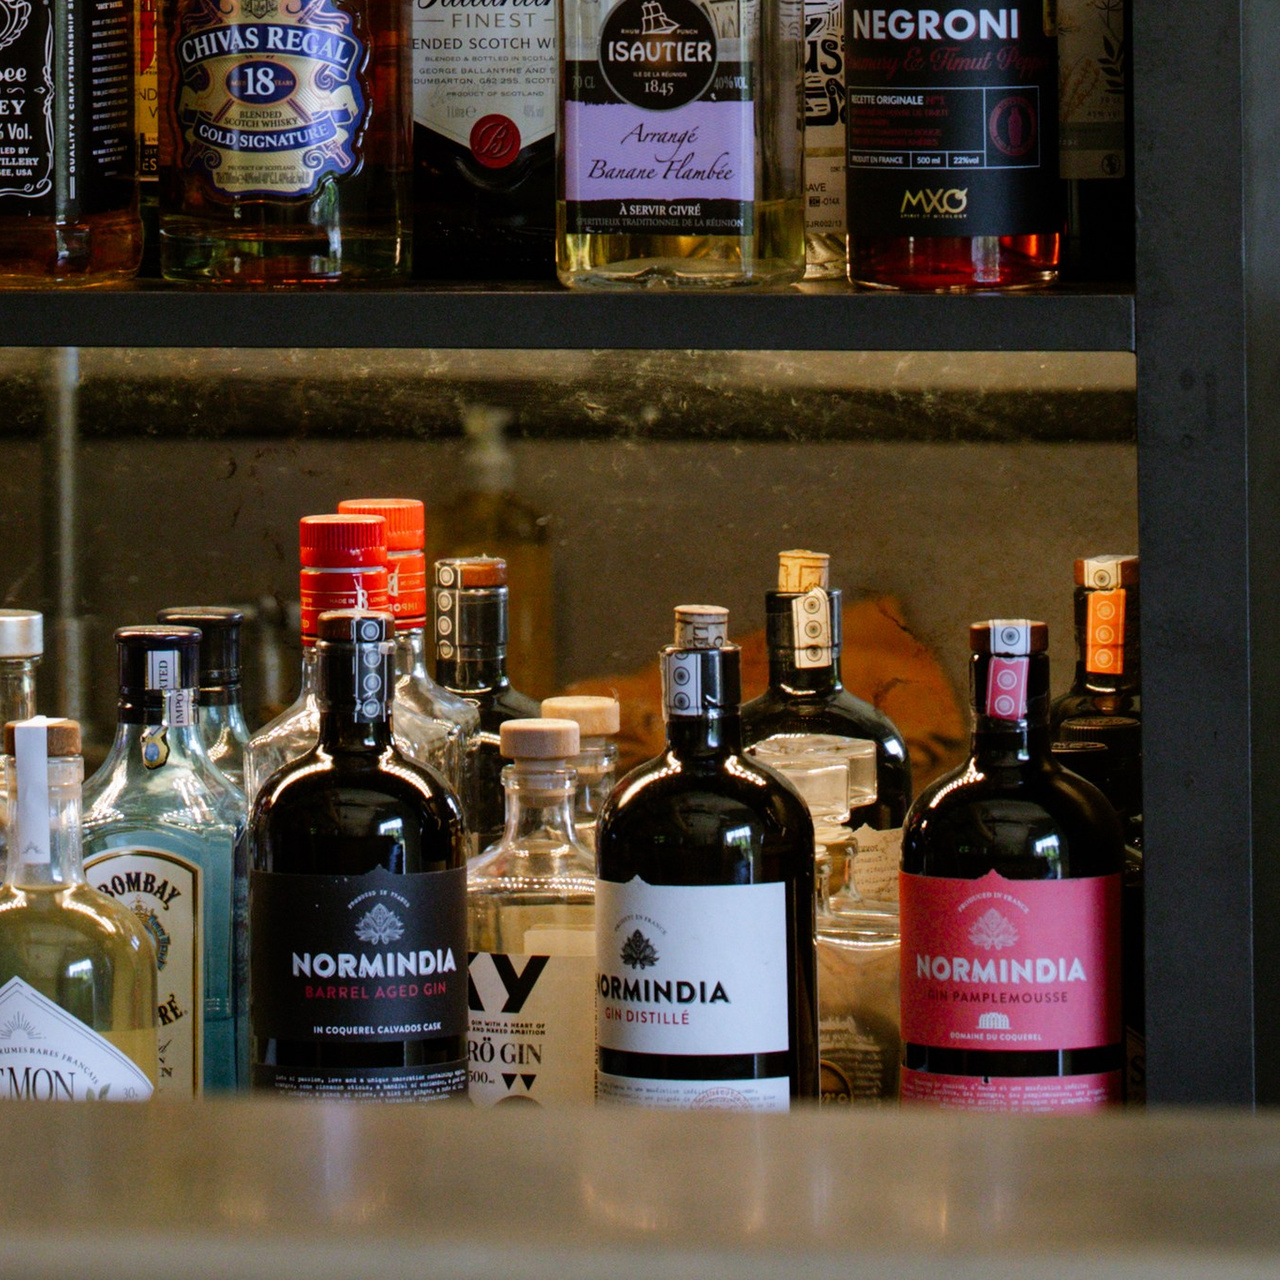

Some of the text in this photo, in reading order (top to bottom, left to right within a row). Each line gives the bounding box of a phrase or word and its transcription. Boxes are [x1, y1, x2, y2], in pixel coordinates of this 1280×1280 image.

[451, 12, 537, 28] FINEST
[852, 7, 1020, 41] NEGRONI
[182, 26, 349, 64] CHIVAS REGAL
[468, 37, 531, 50] SCOTCH
[608, 40, 713, 63] ISAUTIER
[67, 13, 75, 109] CRAFTSMANSHIP
[419, 67, 457, 75] GEORGE
[242, 67, 276, 96] 18
[644, 80, 674, 97] 1845
[876, 94, 924, 105] ORIGINALE
[223, 116, 300, 128] SCOTCH WHISKY
[239, 110, 282, 119] BLENDED
[7, 122, 33, 140] Vol.
[199, 122, 329, 148] GOLD SIGNATURE
[17, 146, 30, 155] BY
[68, 124, 76, 173] QUALITY
[621, 123, 700, 163] Arrangé
[587, 151, 736, 182] Banane Flambée
[878, 156, 904, 164] FRANCE
[15, 168, 33, 177] USA
[629, 202, 701, 216] SERVIR GIVRÉ
[900, 187, 969, 215] MXO
[704, 216, 744, 228] RÉUNION
[99, 871, 182, 910] BOMBAY
[957, 891, 1030, 915] PRODUCED FRANCE
[291, 947, 457, 978] NORMINDIA
[916, 954, 1088, 984] NORMINDIA
[304, 982, 447, 1000] BARREL AGED GIN
[952, 991, 1069, 1004] PAMPLEMOUSSE
[605, 1008, 691, 1025] GIN DISTILLÉ
[313, 1021, 442, 1036] IN COQUEREL CALVADOS CASK
[950, 1031, 1043, 1042] DOMAINE DU COQUEREL
[500, 1042, 543, 1065] GIN
[29, 1046, 60, 1058] RARES
[61, 1053, 100, 1086] FRANÇAIS
